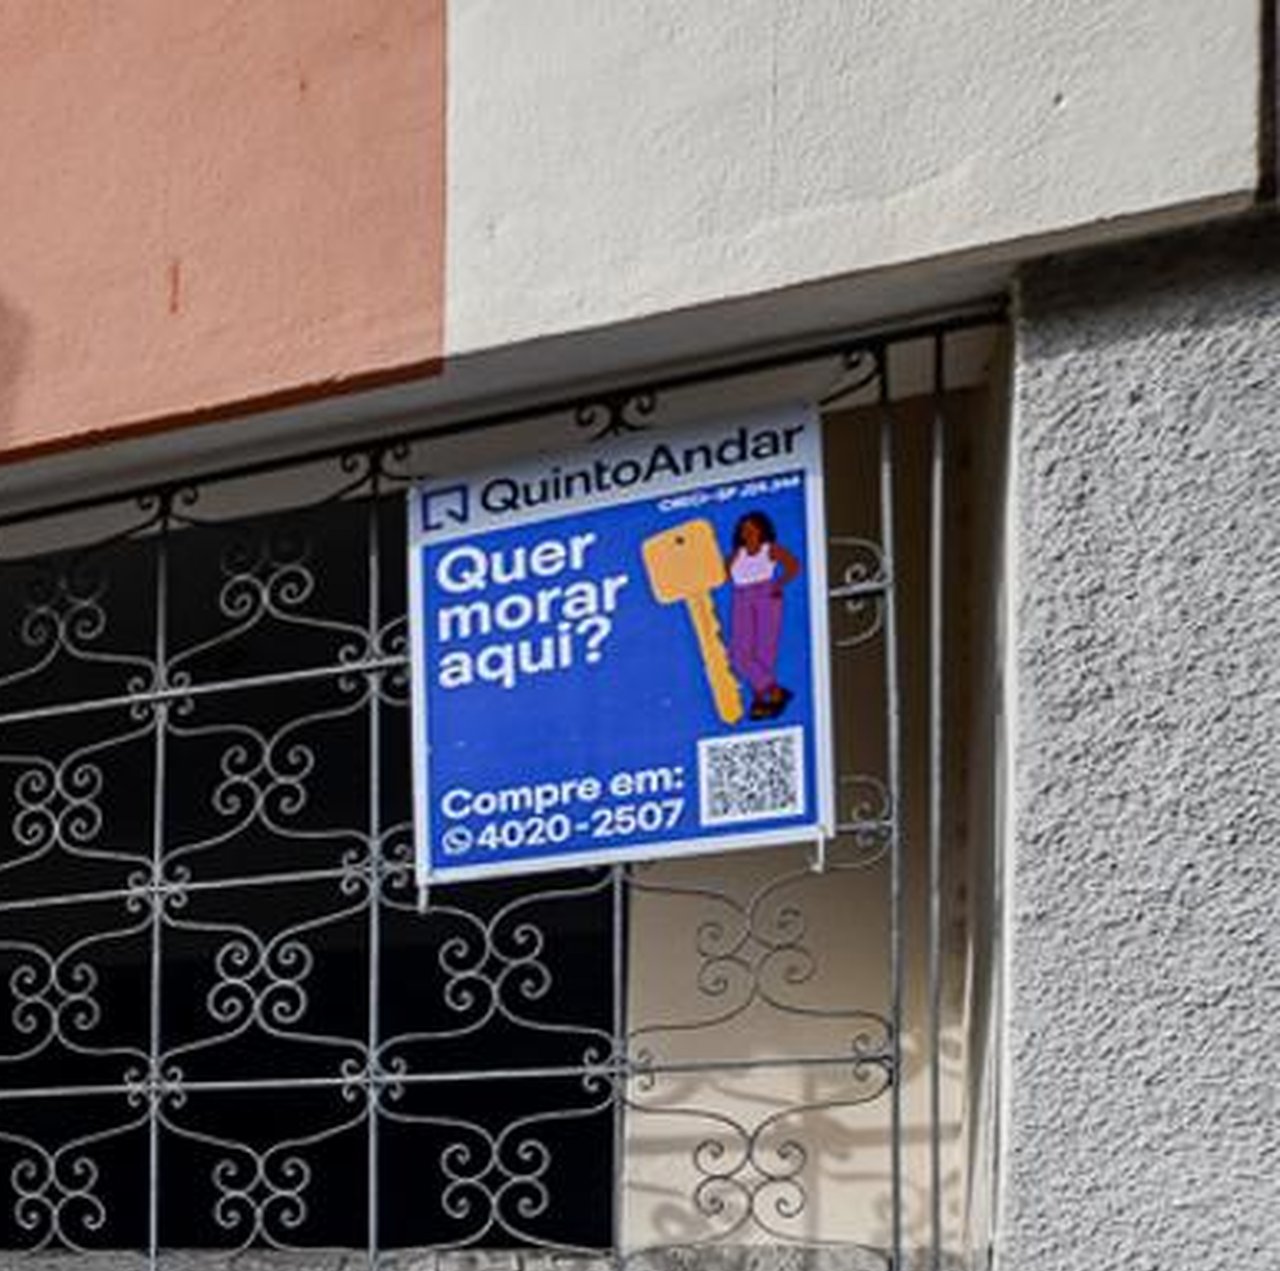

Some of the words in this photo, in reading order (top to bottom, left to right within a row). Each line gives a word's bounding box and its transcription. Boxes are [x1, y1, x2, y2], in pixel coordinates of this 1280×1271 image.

[480, 423, 806, 514] QuintoAndar
[436, 532, 597, 593] Quer
[438, 574, 629, 642] morar
[438, 615, 612, 689] aqui?
[440, 777, 602, 820] Compre
[609, 766, 684, 797] em:
[477, 798, 685, 850] 4020-2507
